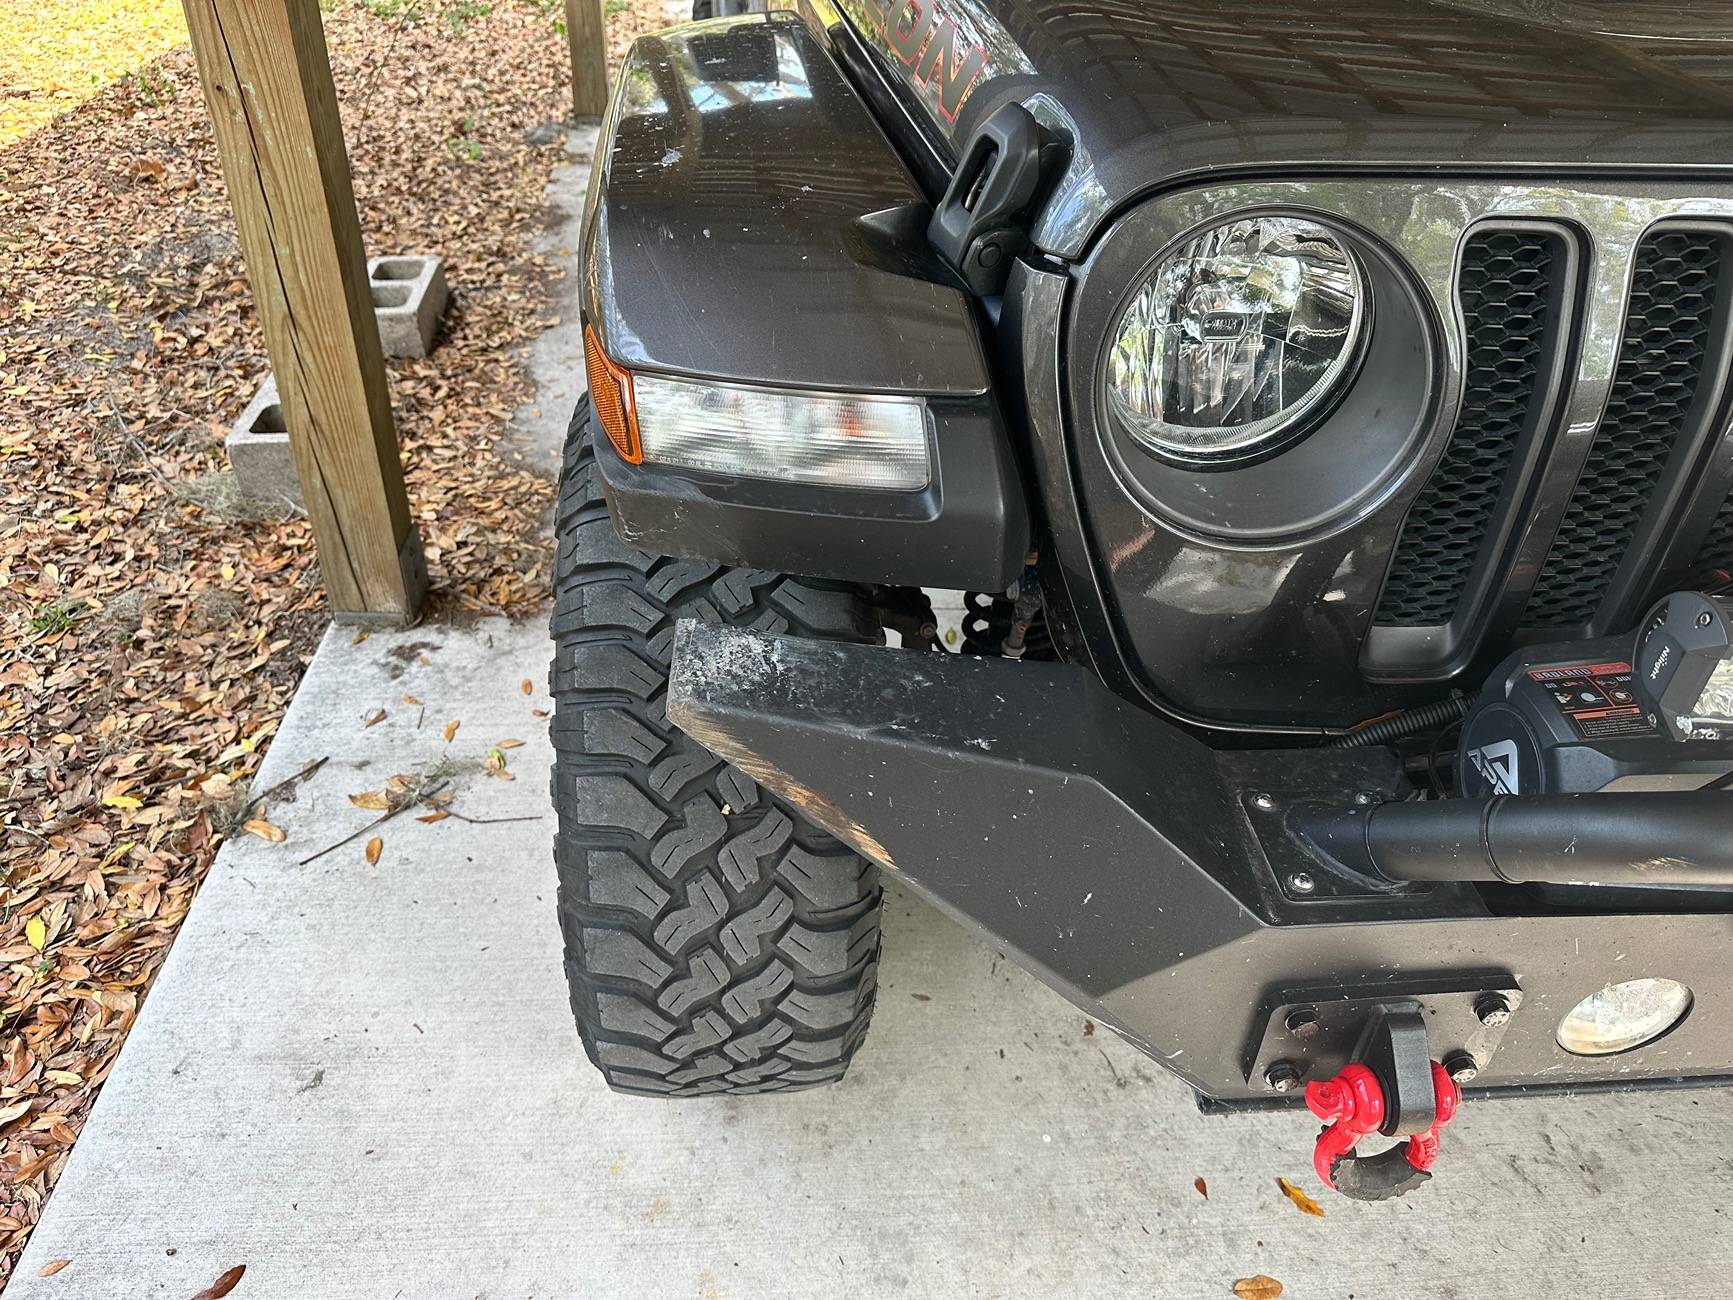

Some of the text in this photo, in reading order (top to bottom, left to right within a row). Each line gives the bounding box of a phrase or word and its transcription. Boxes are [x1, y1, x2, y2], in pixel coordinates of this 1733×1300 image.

[1534, 667, 1592, 679] BADLAND
[1650, 646, 1670, 680] Nilight
[1466, 748, 1509, 796] APE
